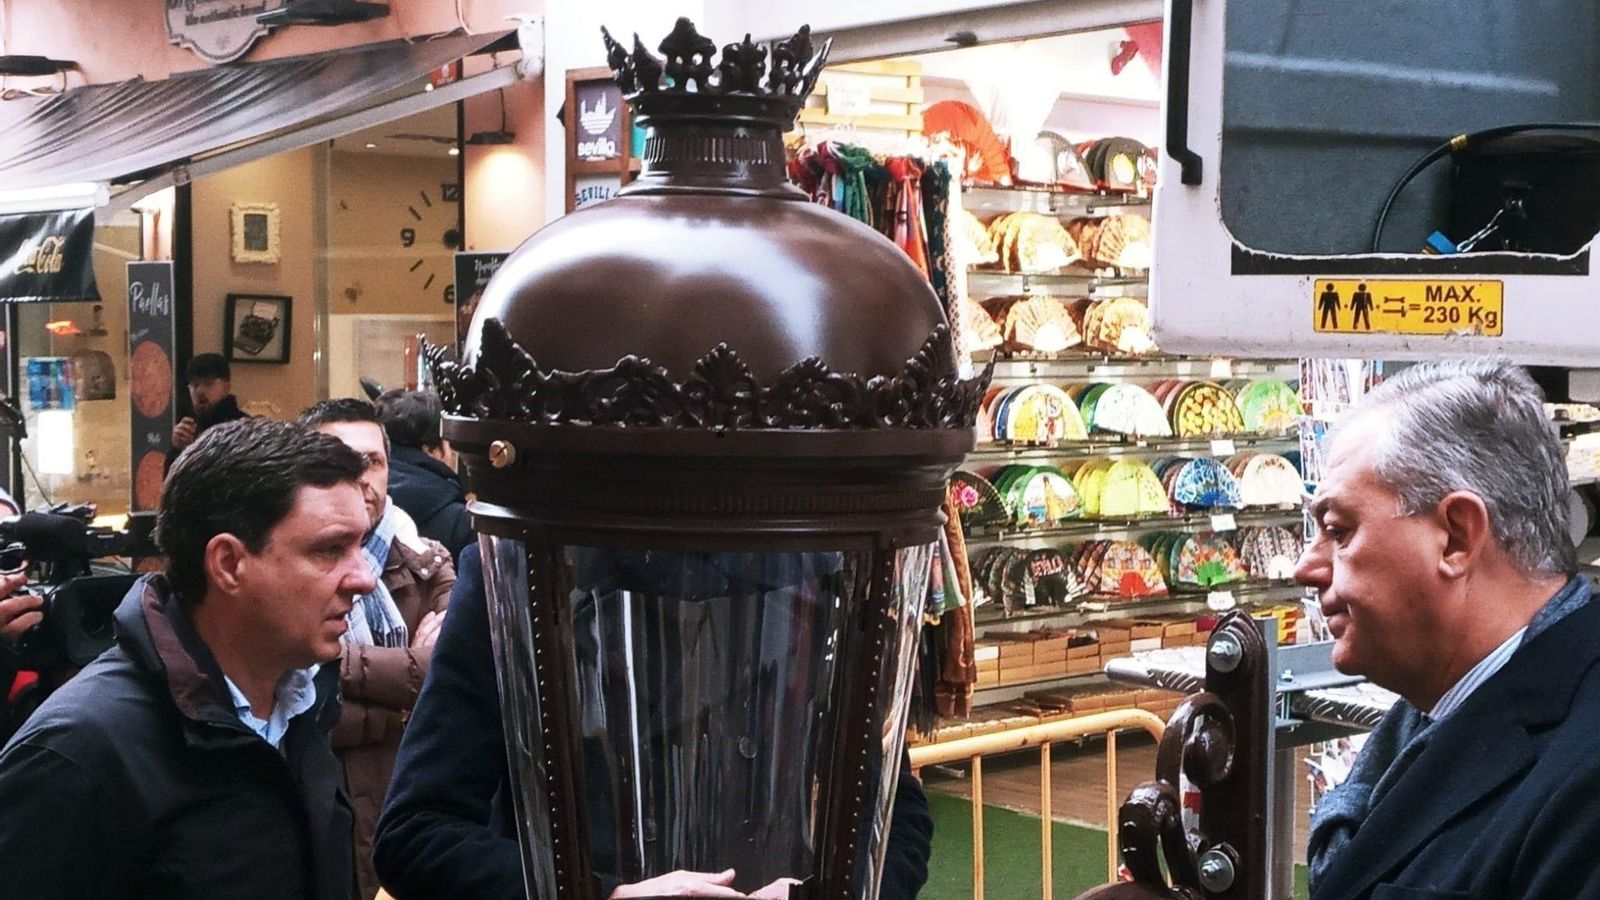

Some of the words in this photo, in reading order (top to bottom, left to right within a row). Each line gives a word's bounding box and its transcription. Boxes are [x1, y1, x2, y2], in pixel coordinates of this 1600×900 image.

[577, 136, 616, 157] sevilla
[575, 185, 619, 206] SEVILL
[400, 228, 415, 248] 9
[129, 281, 169, 317] Paellas
[1425, 285, 1481, 303] MAX.
[1423, 306, 1460, 324] 230
[1468, 306, 1498, 329] Kg
[1030, 554, 1065, 577] SEVILLA
